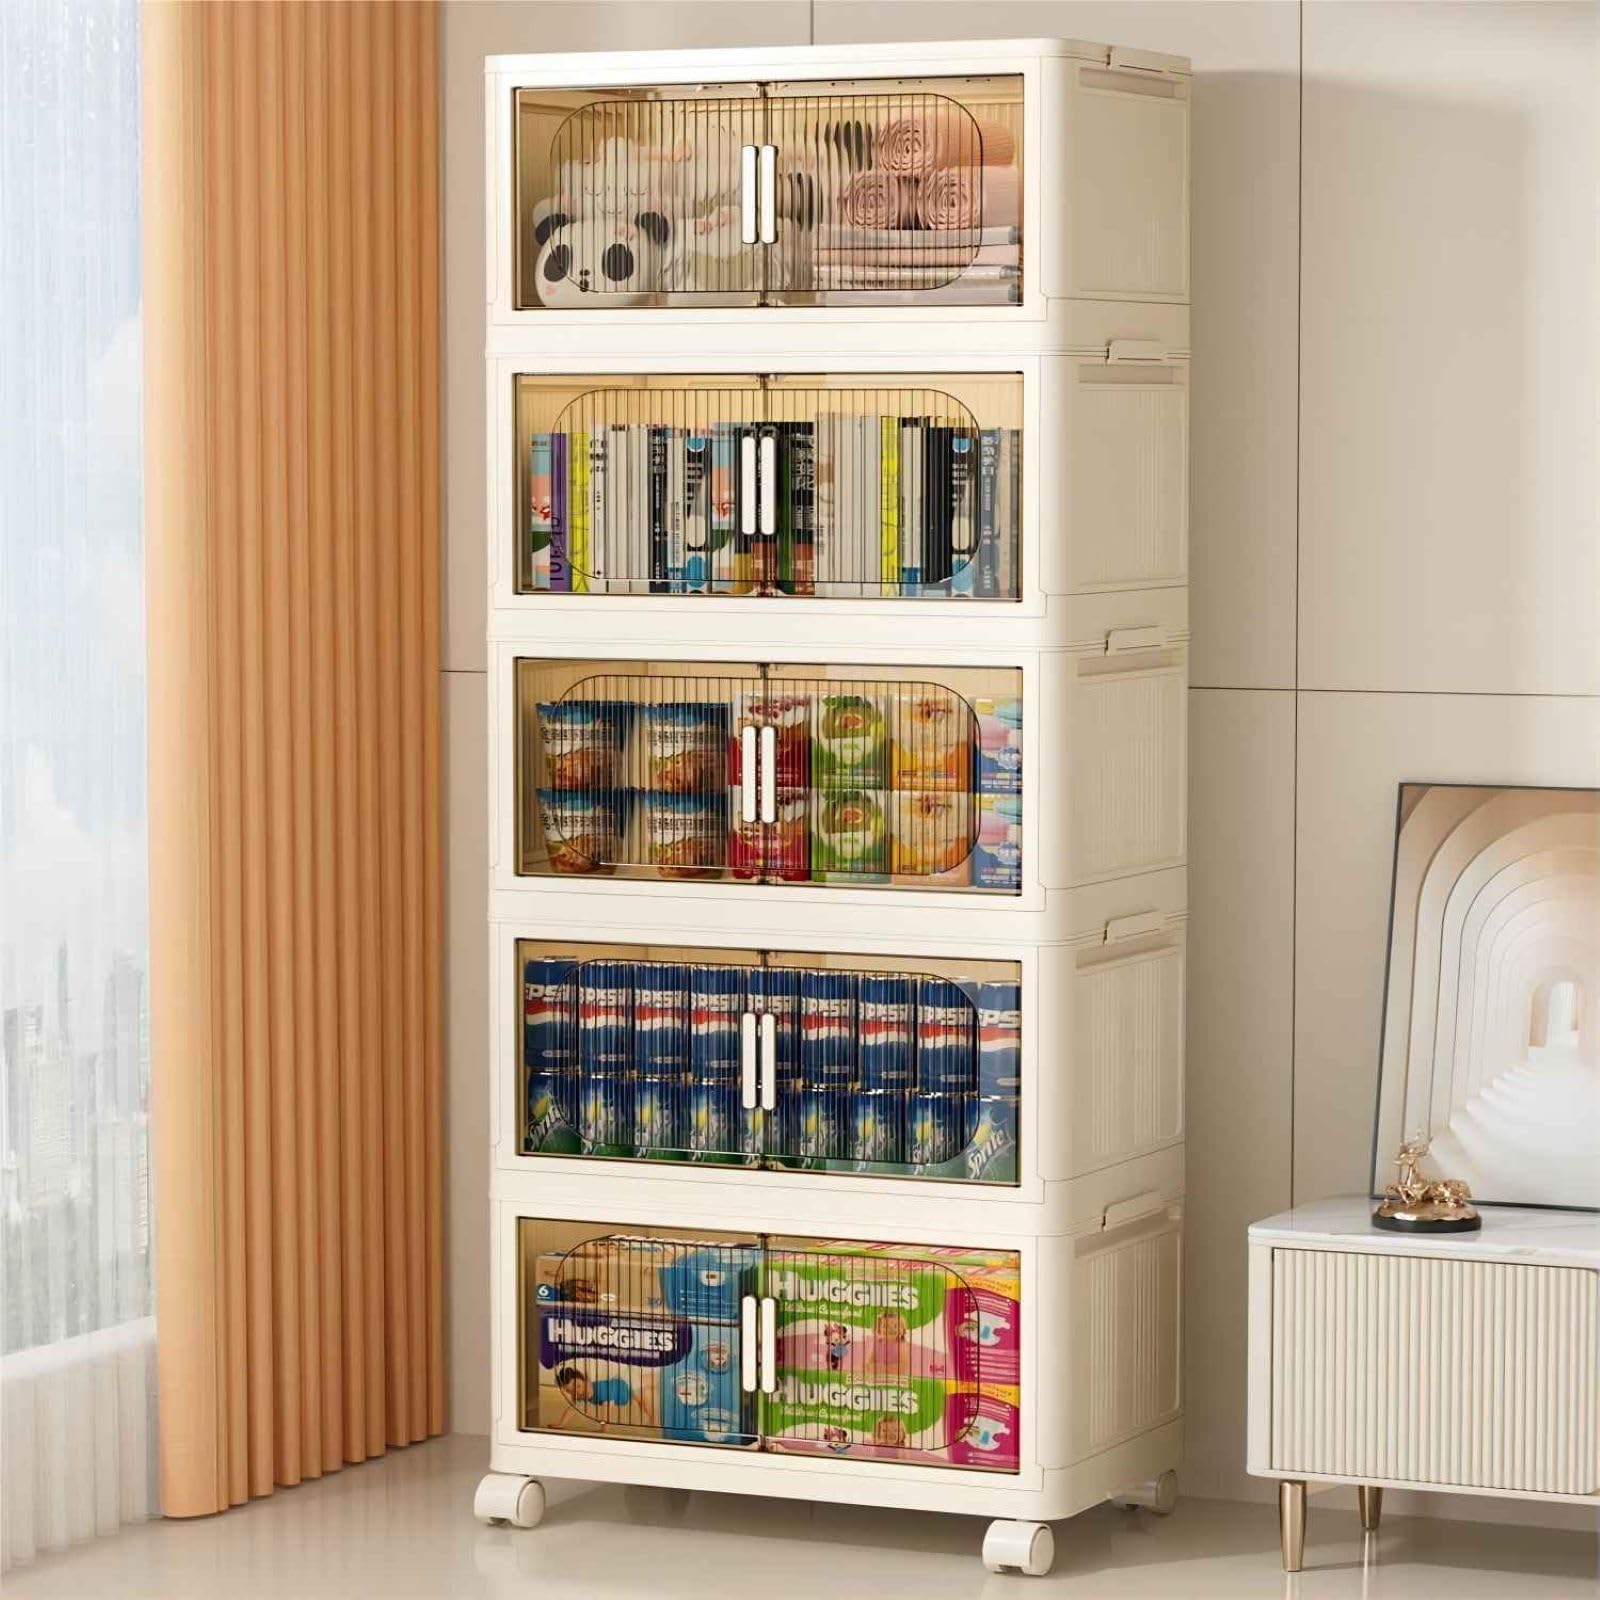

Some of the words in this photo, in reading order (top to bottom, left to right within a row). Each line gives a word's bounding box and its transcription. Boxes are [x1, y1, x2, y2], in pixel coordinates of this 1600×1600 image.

[538, 1285, 549, 1297] 6
[768, 1269, 919, 1310] HUGGIES
[547, 1316, 674, 1352] HUGGIES
[771, 1376, 919, 1415] HUGGIES
